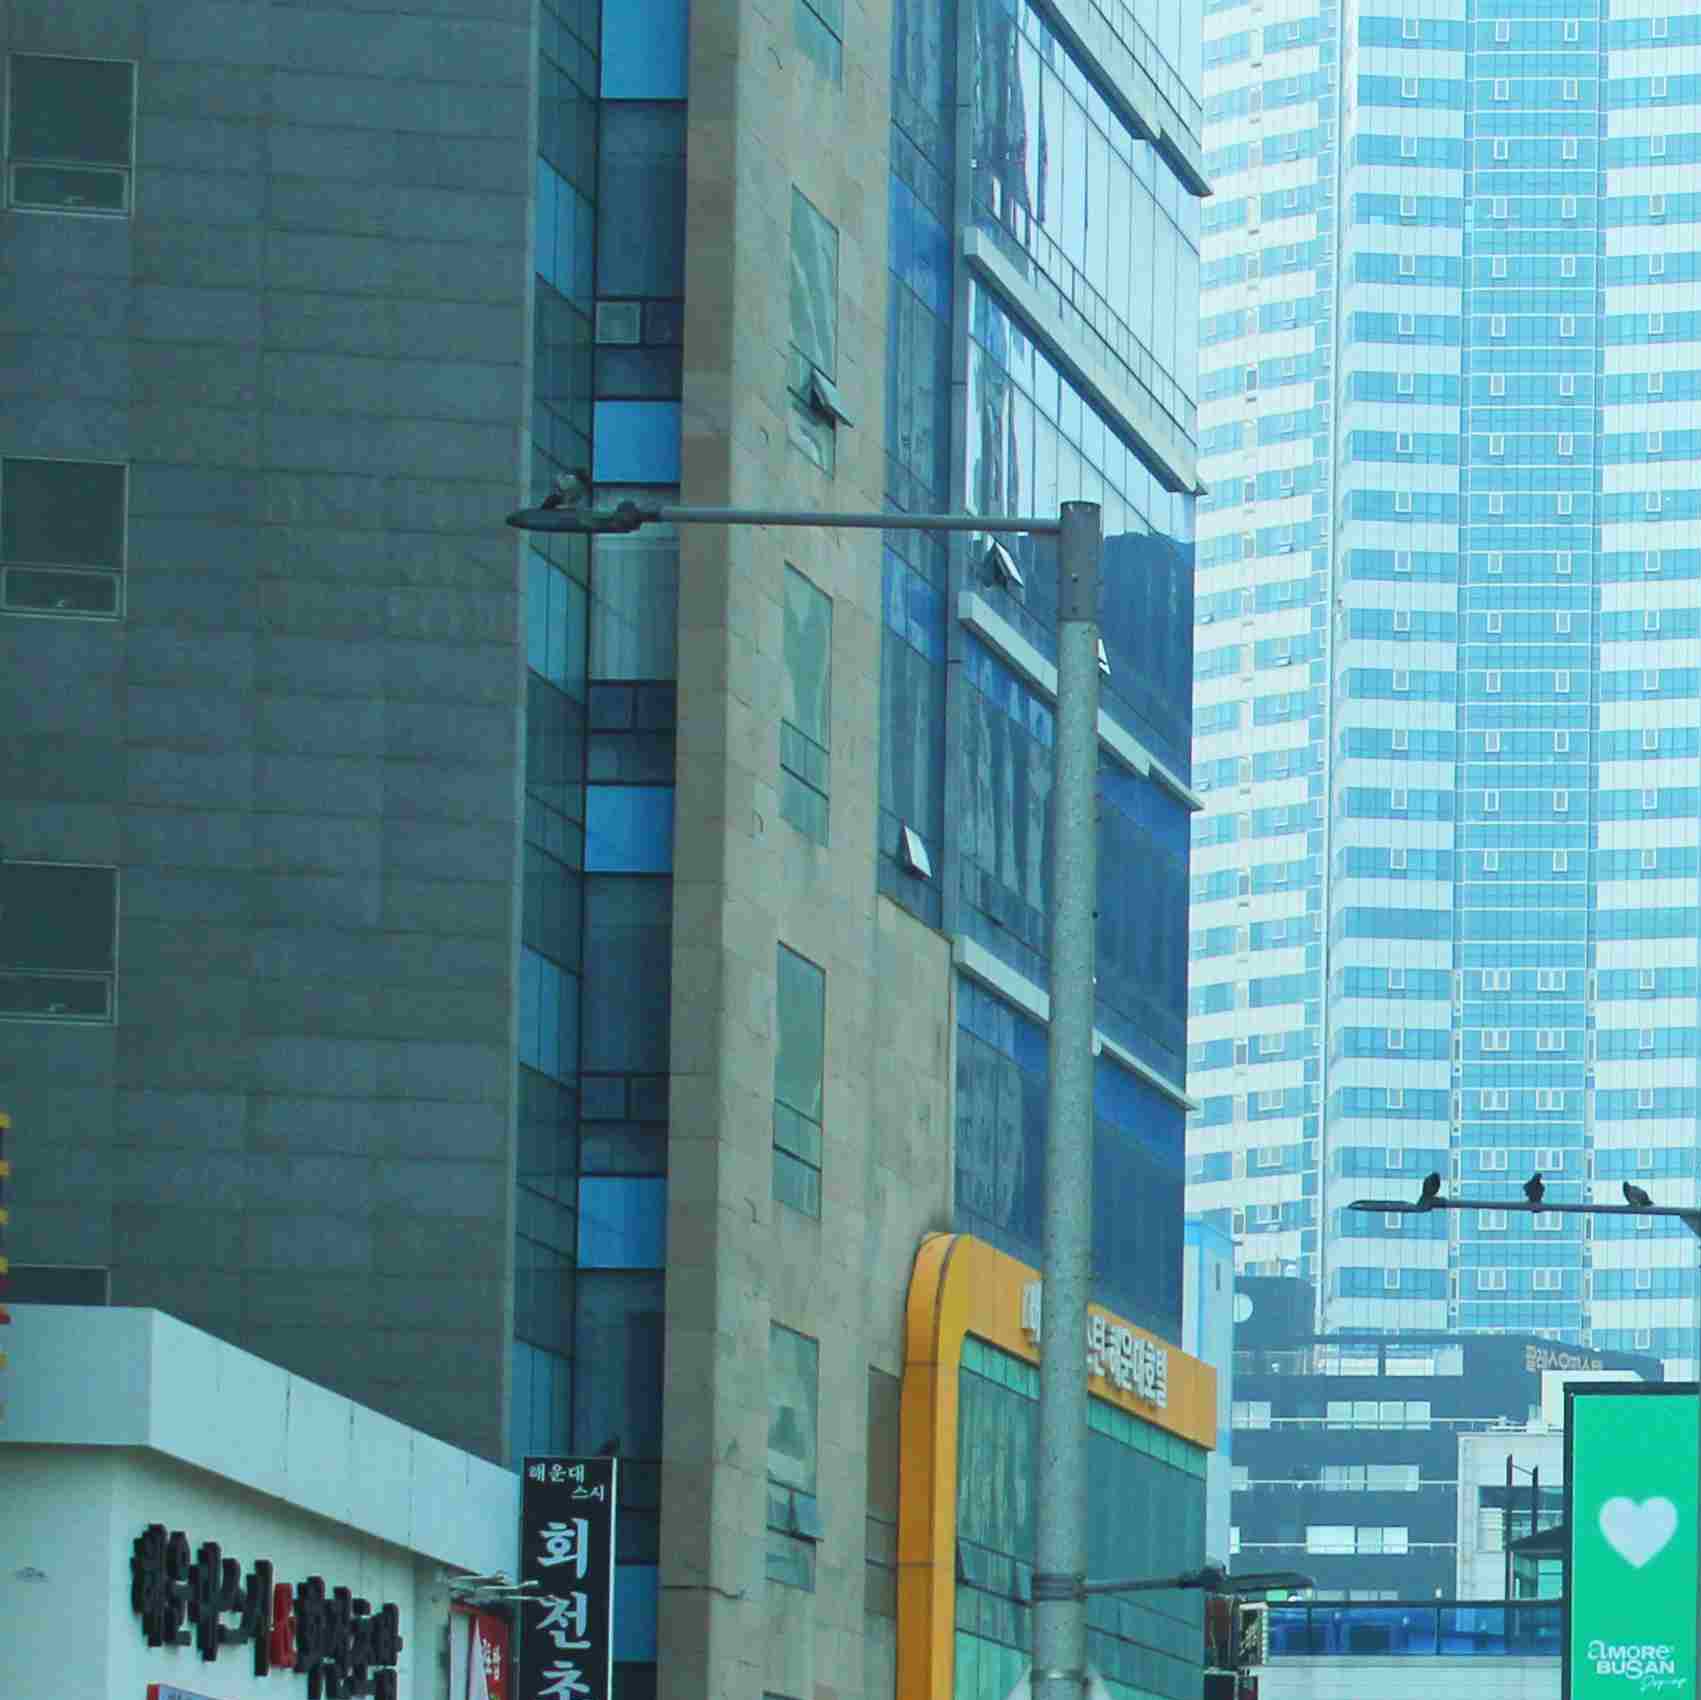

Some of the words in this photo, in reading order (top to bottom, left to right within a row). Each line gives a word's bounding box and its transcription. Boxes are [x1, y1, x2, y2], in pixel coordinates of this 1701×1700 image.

[527, 1463, 585, 1484] 해운대
[570, 1485, 606, 1502] 스시
[1597, 1660, 1675, 1679] BUSAN
